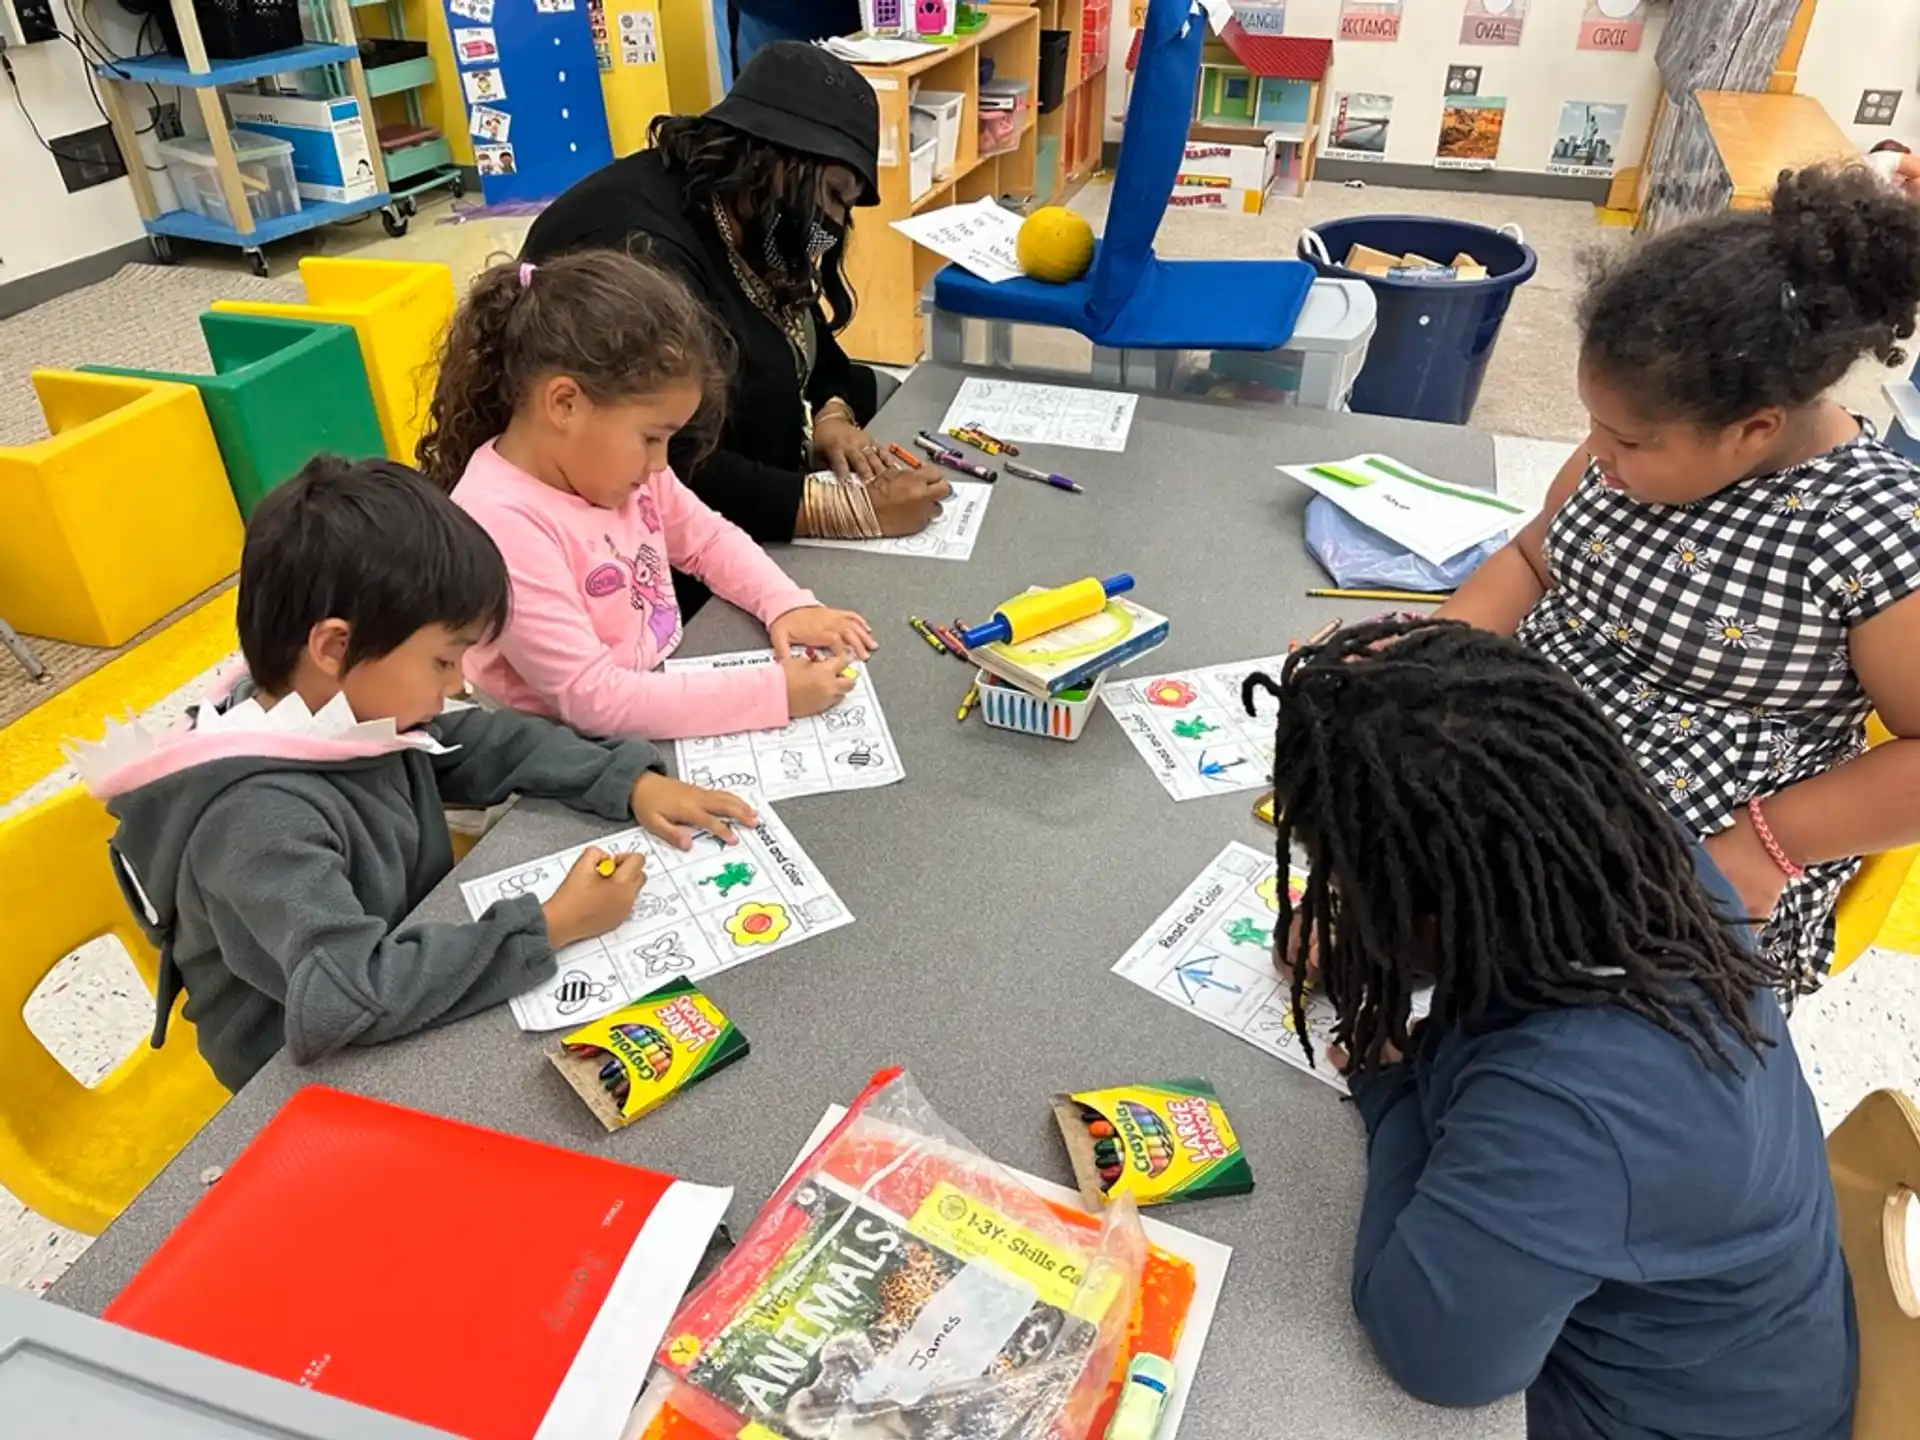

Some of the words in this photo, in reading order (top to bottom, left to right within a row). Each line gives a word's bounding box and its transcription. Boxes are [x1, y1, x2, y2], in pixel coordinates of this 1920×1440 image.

[1475, 21, 1506, 40] OVAL
[769, 846, 790, 864] and
[781, 862, 804, 887] Color
[1158, 922, 1189, 949] Read
[1184, 904, 1205, 924] and
[1198, 884, 1224, 907] Color
[655, 1004, 706, 1053] LARGE
[675, 995, 722, 1041] CRAYONS
[608, 1029, 655, 1080] Crayola
[1115, 1103, 1150, 1173] Crayola
[1167, 1100, 1211, 1163] LARGE
[1187, 1095, 1229, 1160] CRAYONS
[1007, 1236, 1057, 1272] Skills
[732, 1217, 900, 1416] ANIMALS
[907, 1314, 962, 1371] James
